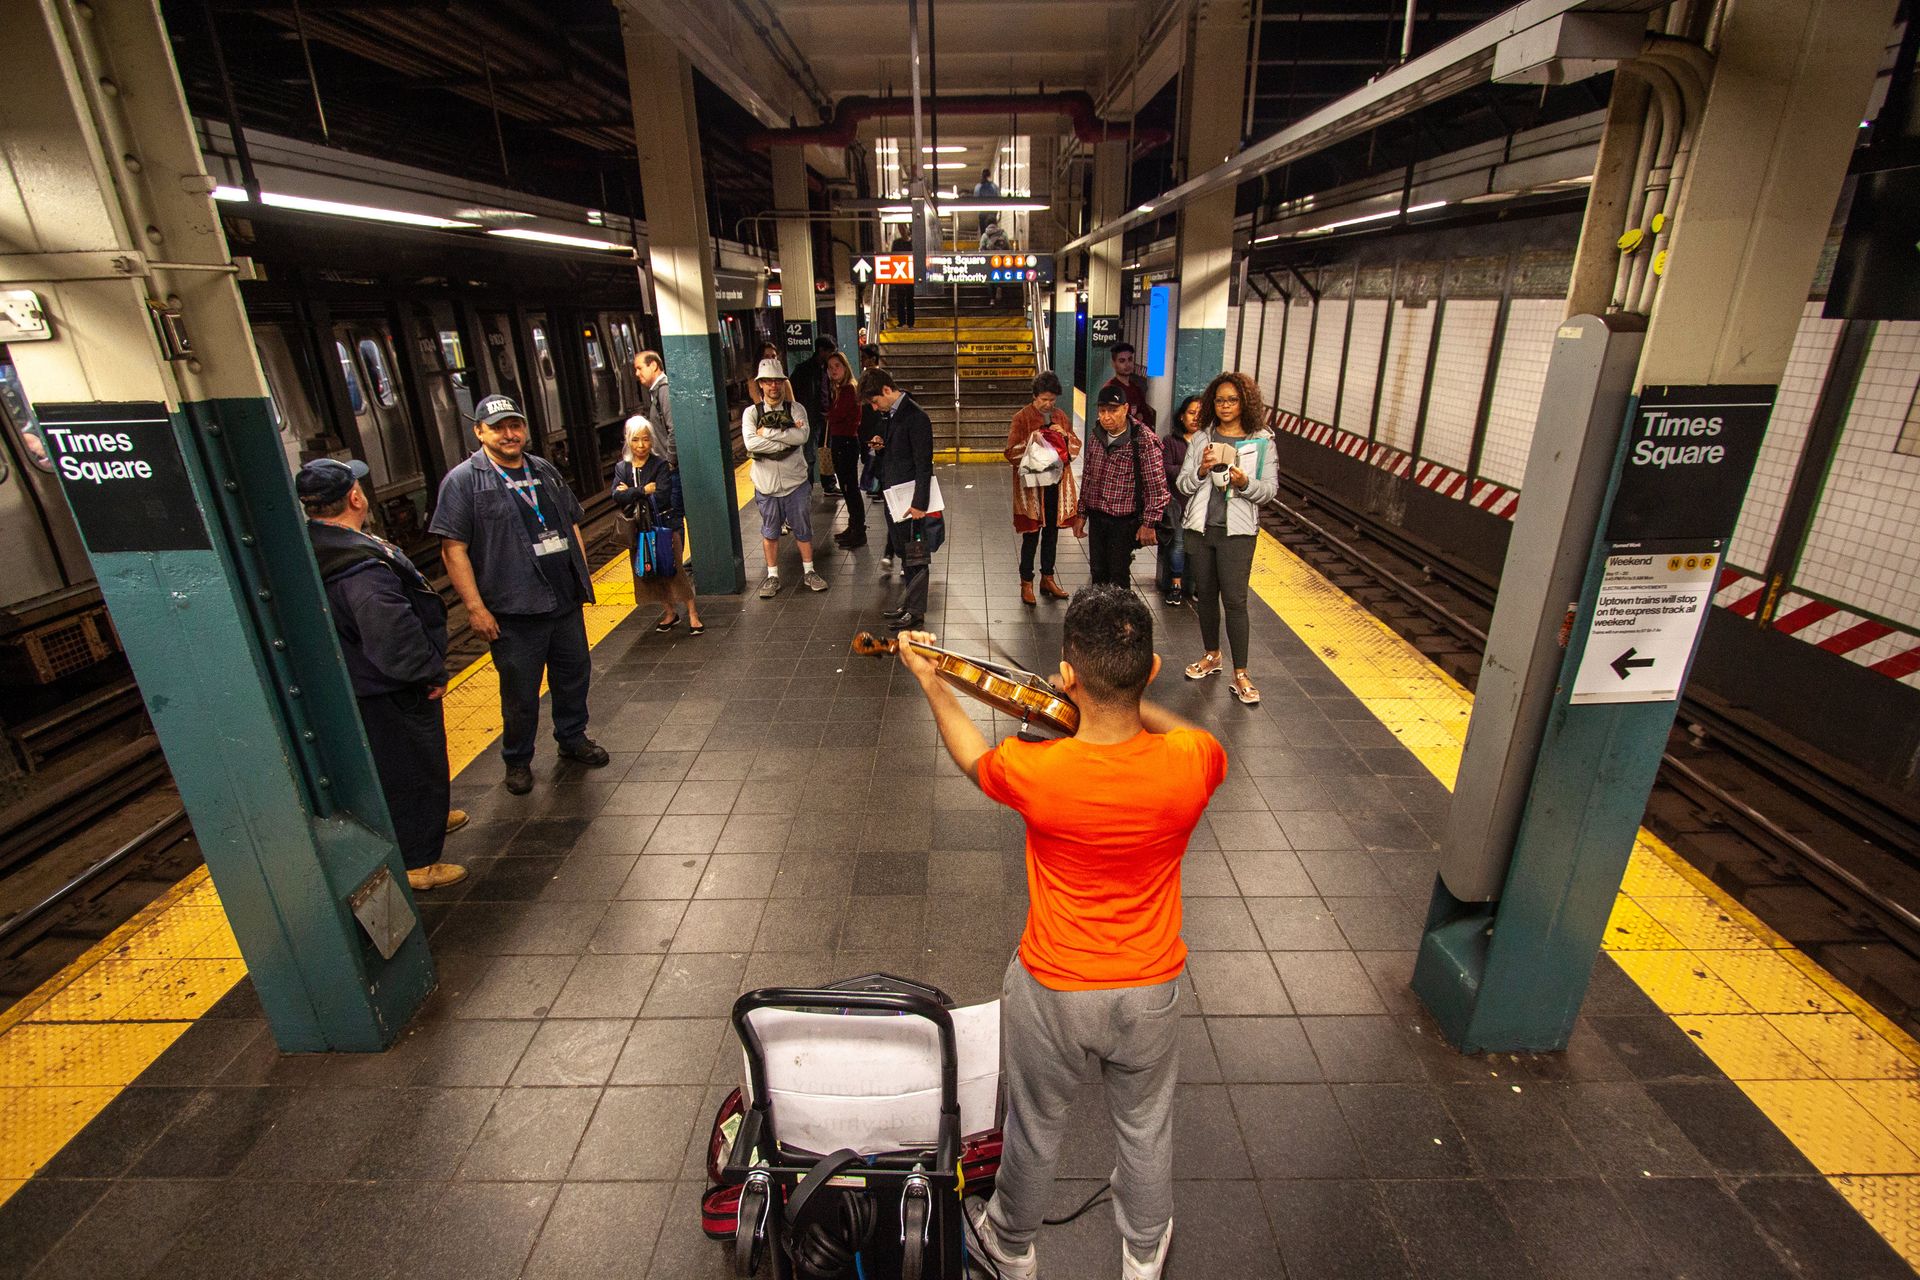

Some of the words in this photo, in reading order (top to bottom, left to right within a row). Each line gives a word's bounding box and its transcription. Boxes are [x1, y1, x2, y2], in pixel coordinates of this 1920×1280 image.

[954, 255, 986, 266] Square
[876, 256, 914, 279] Exi
[942, 264, 968, 274] Street
[947, 272, 987, 283] Authority
[786, 324, 802, 335] 42
[1093, 320, 1108, 331] 42
[787, 338, 811, 346] Street
[1642, 411, 1724, 437] Times
[46, 428, 134, 453] Times
[1631, 439, 1725, 470] Square
[59, 455, 153, 485] Square
[1609, 556, 1653, 566] Weekend
[1599, 597, 1634, 607] Uptown
[1635, 595, 1660, 605] trains
[1661, 595, 1677, 604] will
[1678, 595, 1697, 606] stop
[1596, 609, 1609, 617] on
[1609, 607, 1624, 616] the
[1625, 608, 1660, 617] express
[1662, 606, 1684, 614] track
[1684, 604, 1697, 613] all
[1594, 617, 1636, 627] weekend
